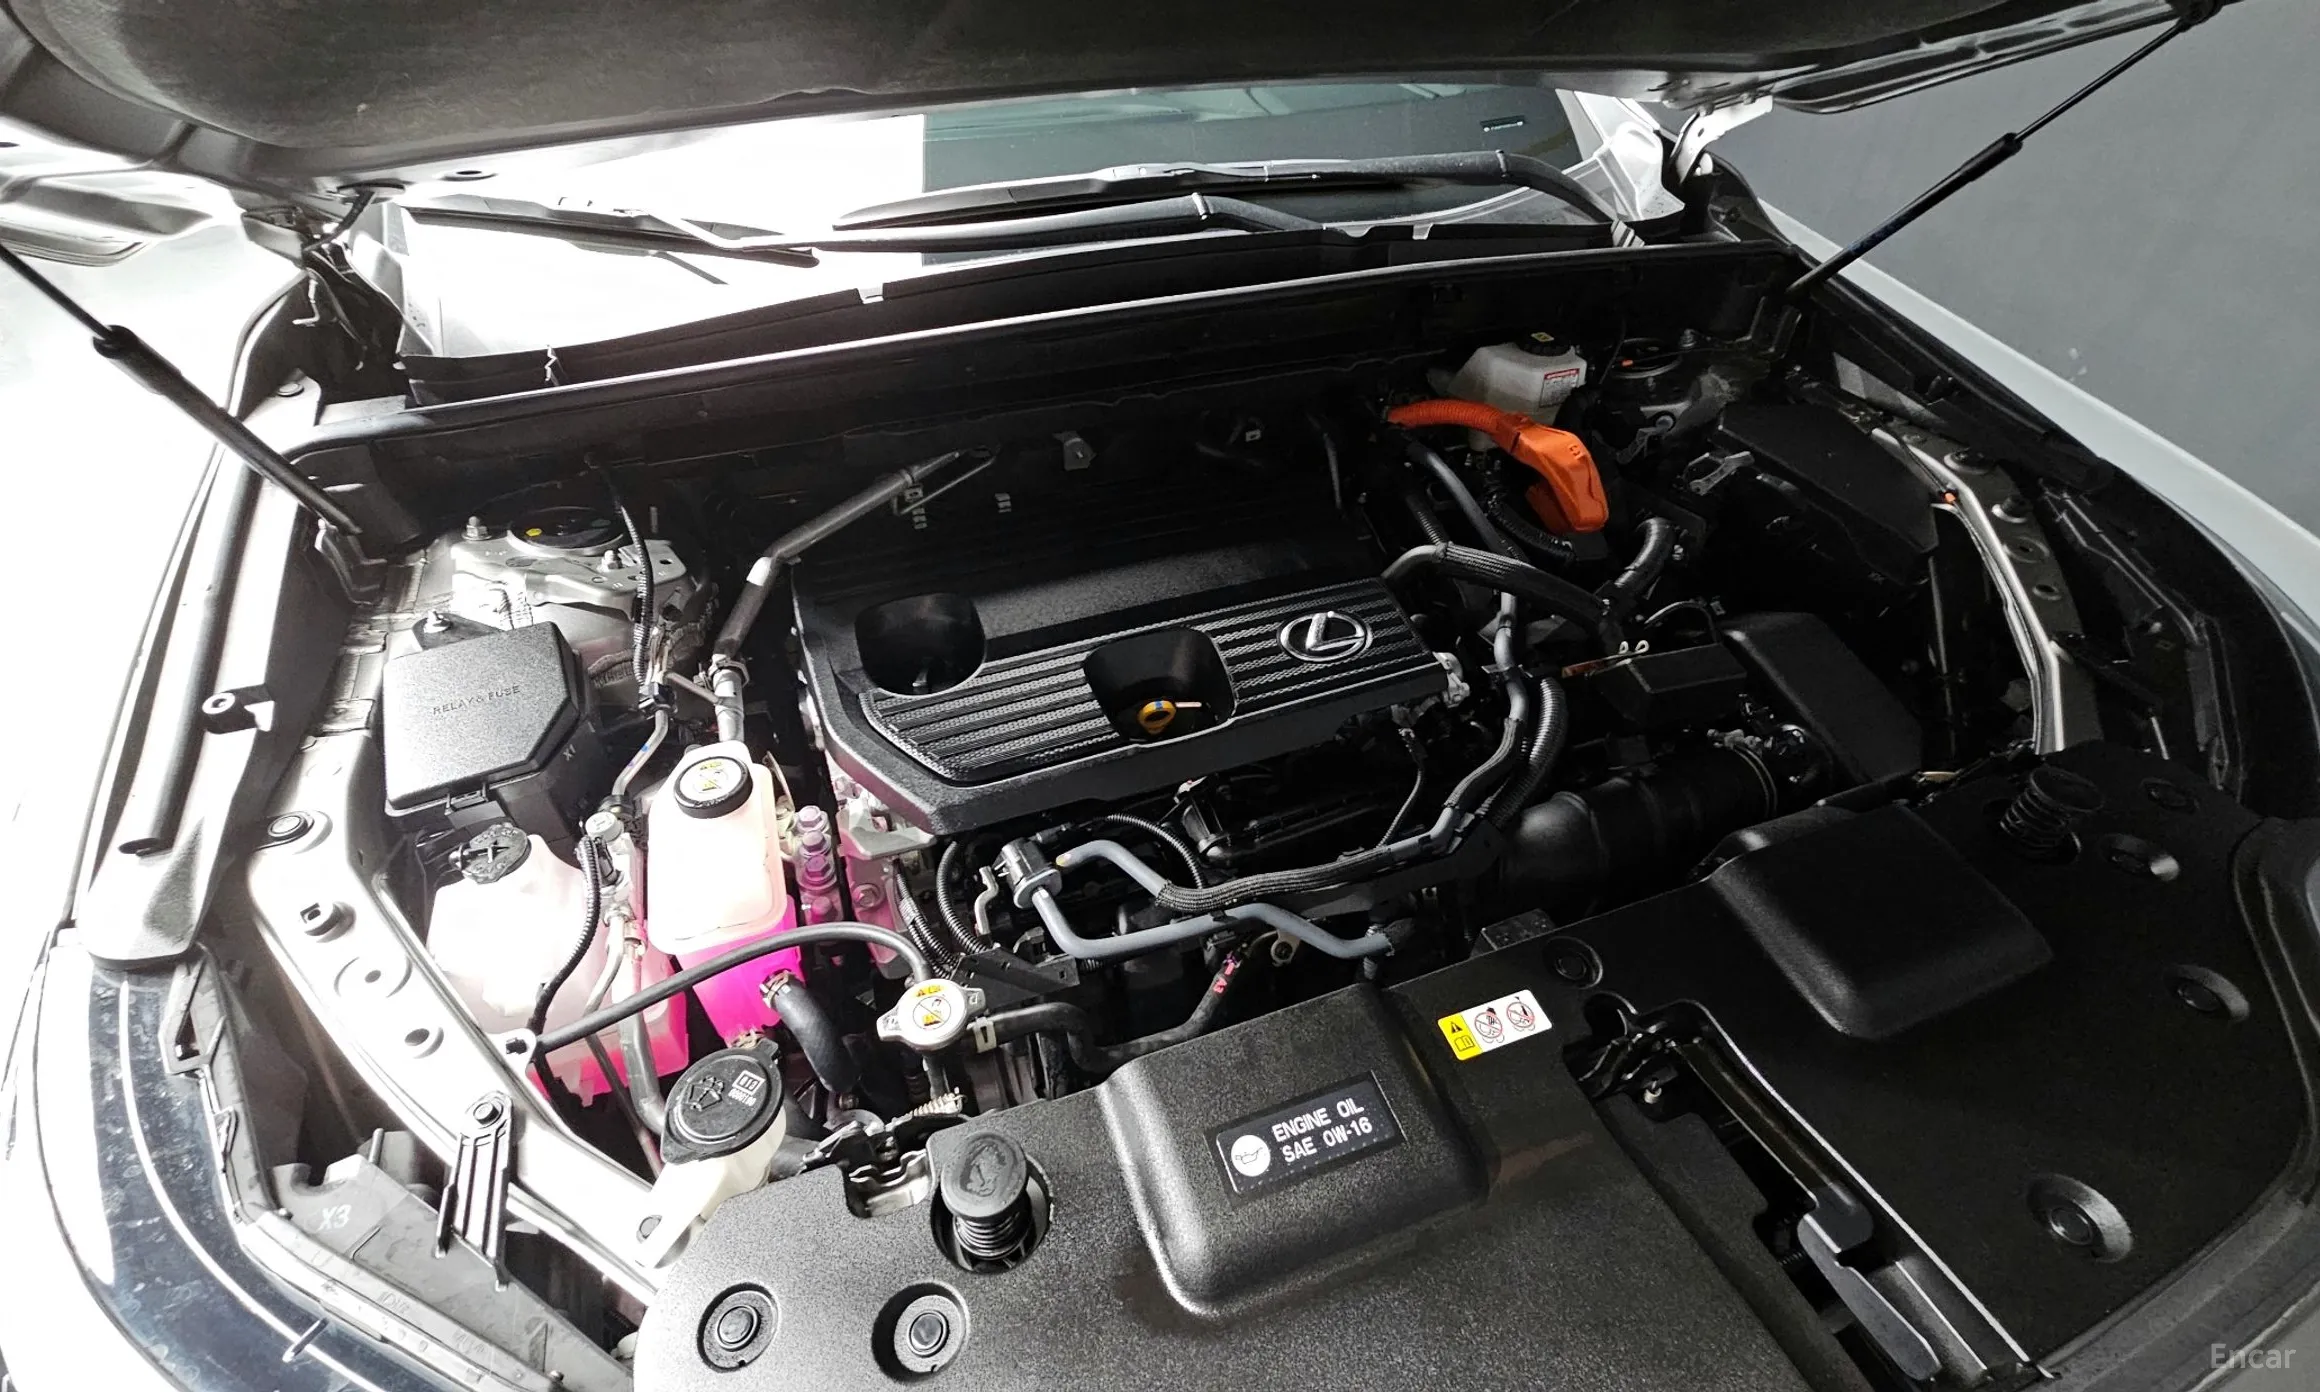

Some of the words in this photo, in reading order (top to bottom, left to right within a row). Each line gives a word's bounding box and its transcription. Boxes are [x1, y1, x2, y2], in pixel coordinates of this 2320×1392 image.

[432, 696, 474, 715] RELAY
[487, 684, 521, 701] FUSE
[1271, 1107, 1332, 1142] ENGINE
[1336, 1097, 1365, 1118] OIL
[1282, 1136, 1318, 1163] SAE
[1322, 1116, 1373, 1147] 0W-16
[320, 1204, 352, 1230] X3
